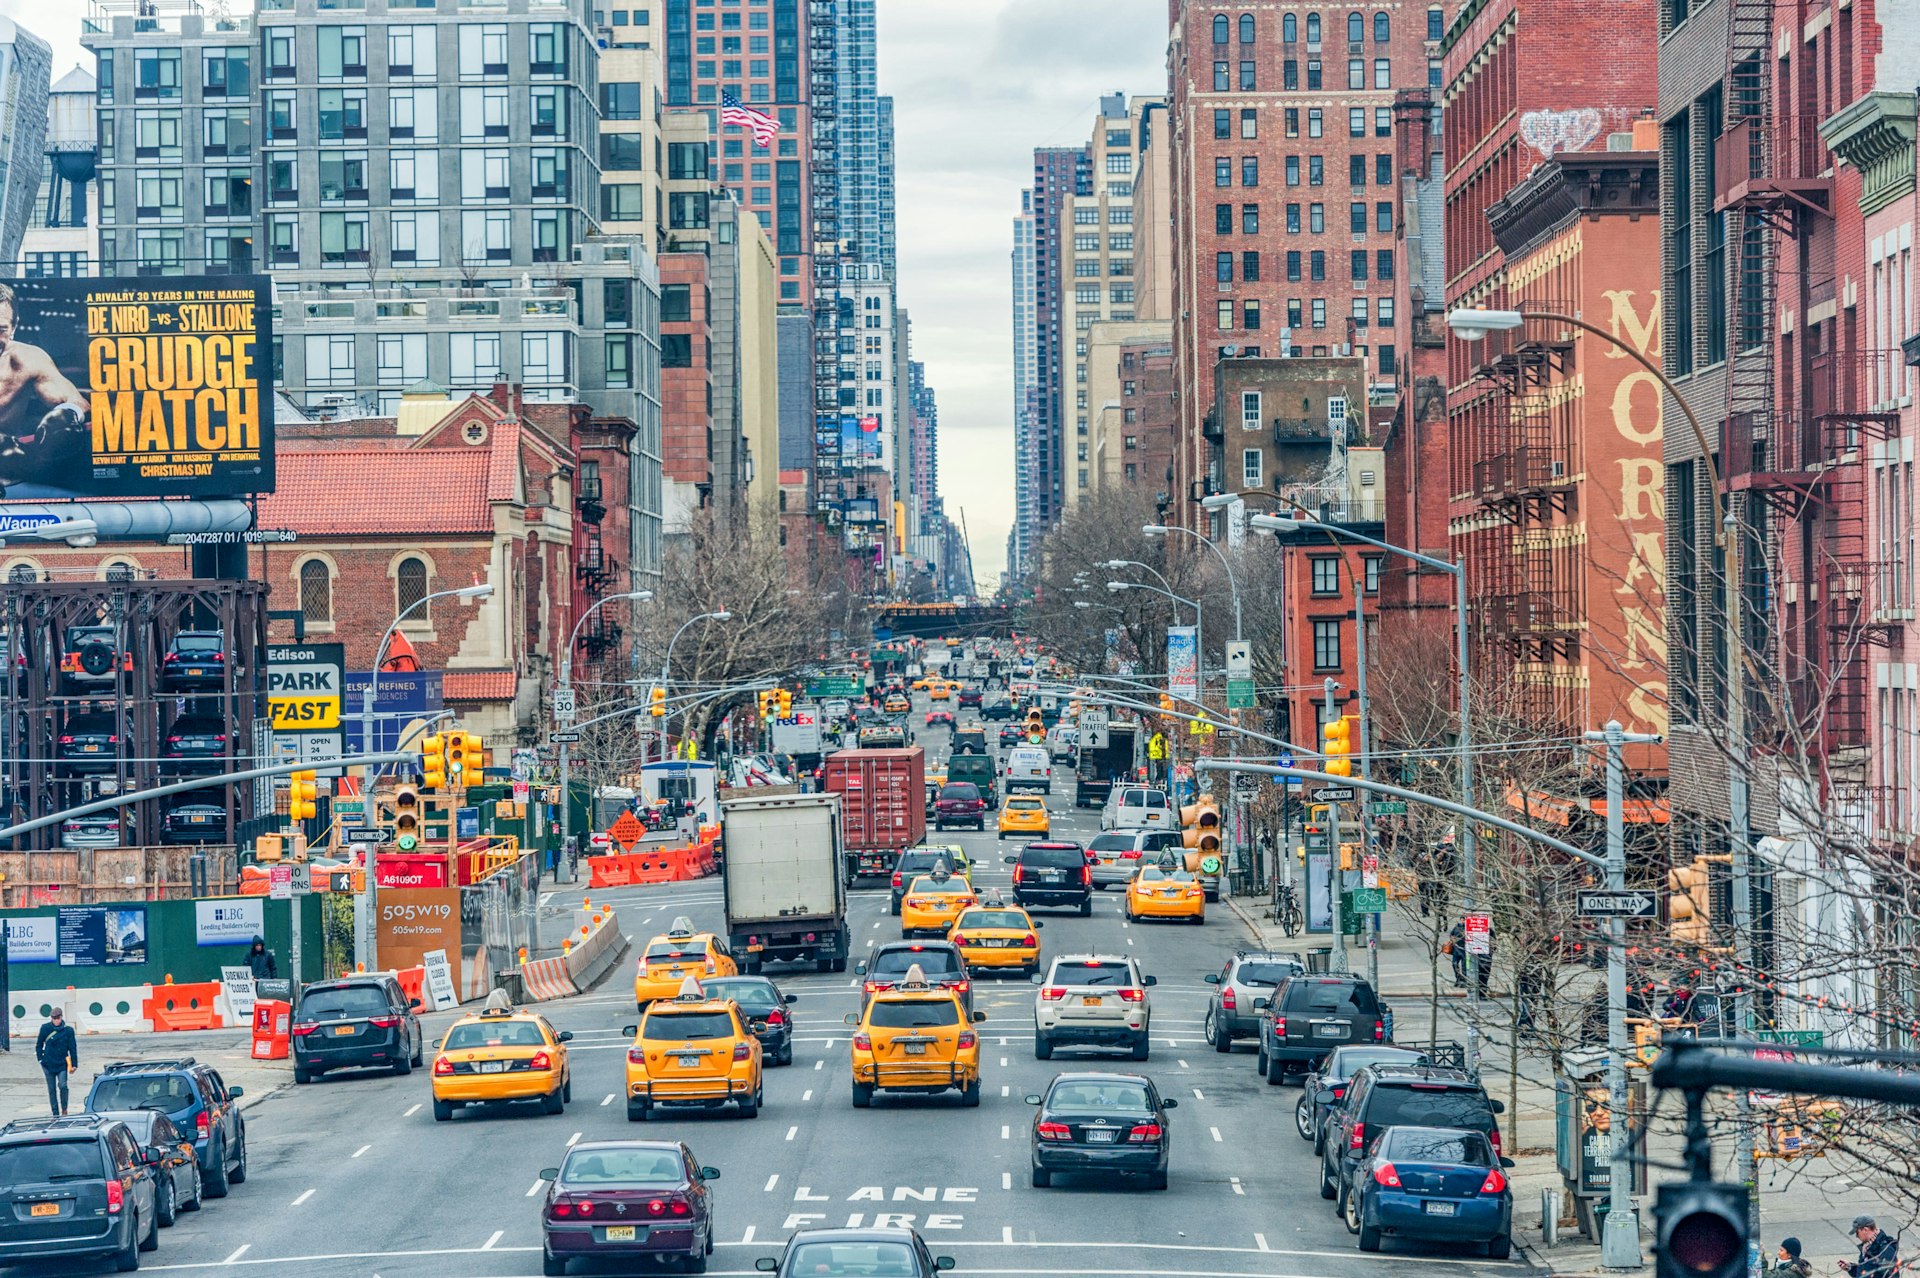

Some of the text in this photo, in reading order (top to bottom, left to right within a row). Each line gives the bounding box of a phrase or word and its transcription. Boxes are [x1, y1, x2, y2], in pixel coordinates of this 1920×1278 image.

[87, 289, 255, 302] A RIVALRY 30 YEARS IN THE MAKING
[87, 306, 109, 334] DE
[111, 305, 149, 333] NIRO
[178, 304, 256, 332] STALLONE
[88, 335, 258, 392] GRUDGE
[90, 389, 260, 453] MATCH
[92, 456, 110, 465] KEVIN
[111, 455, 127, 464] HART
[132, 455, 149, 464] ALAN
[171, 454, 183, 463] KIM
[184, 453, 212, 462] BASINGER
[218, 453, 230, 462] JON
[231, 452, 260, 461] BERNTHAL
[140, 463, 213, 477] CHRISTMAS DAY
[0, 516, 55, 534] Wagner
[185, 532, 222, 544] 2047287
[224, 532, 235, 543] 01
[236, 532, 241, 543] /
[1169, 637, 1193, 646] Raqib
[267, 649, 315, 661] Edison
[268, 671, 332, 691] PARK
[378, 681, 418, 691] REFINED.
[271, 702, 332, 721] FAST
[556, 701, 572, 711] 30
[1082, 723, 1107, 731] TRAFFIC
[1335, 790, 1349, 798] WAY
[345, 803, 354, 811] 19
[1375, 803, 1382, 812] W
[1385, 803, 1394, 812] 19
[353, 831, 385, 839] ONE WAY
[1588, 898, 1644, 909] ONE WAY
[224, 908, 244, 921] LBG
[383, 904, 451, 921] 505W19
[200, 923, 221, 931] Leeding
[243, 921, 260, 929] Group
[392, 925, 442, 935] 505w19.com
[12, 926, 34, 939] LBG
[9, 940, 52, 949] Builders Group
[225, 971, 250, 981] SIDEWALK
[1806, 1032, 1818, 1040] ST
[793, 1186, 979, 1202] LANE
[782, 1213, 964, 1230] FIRE
